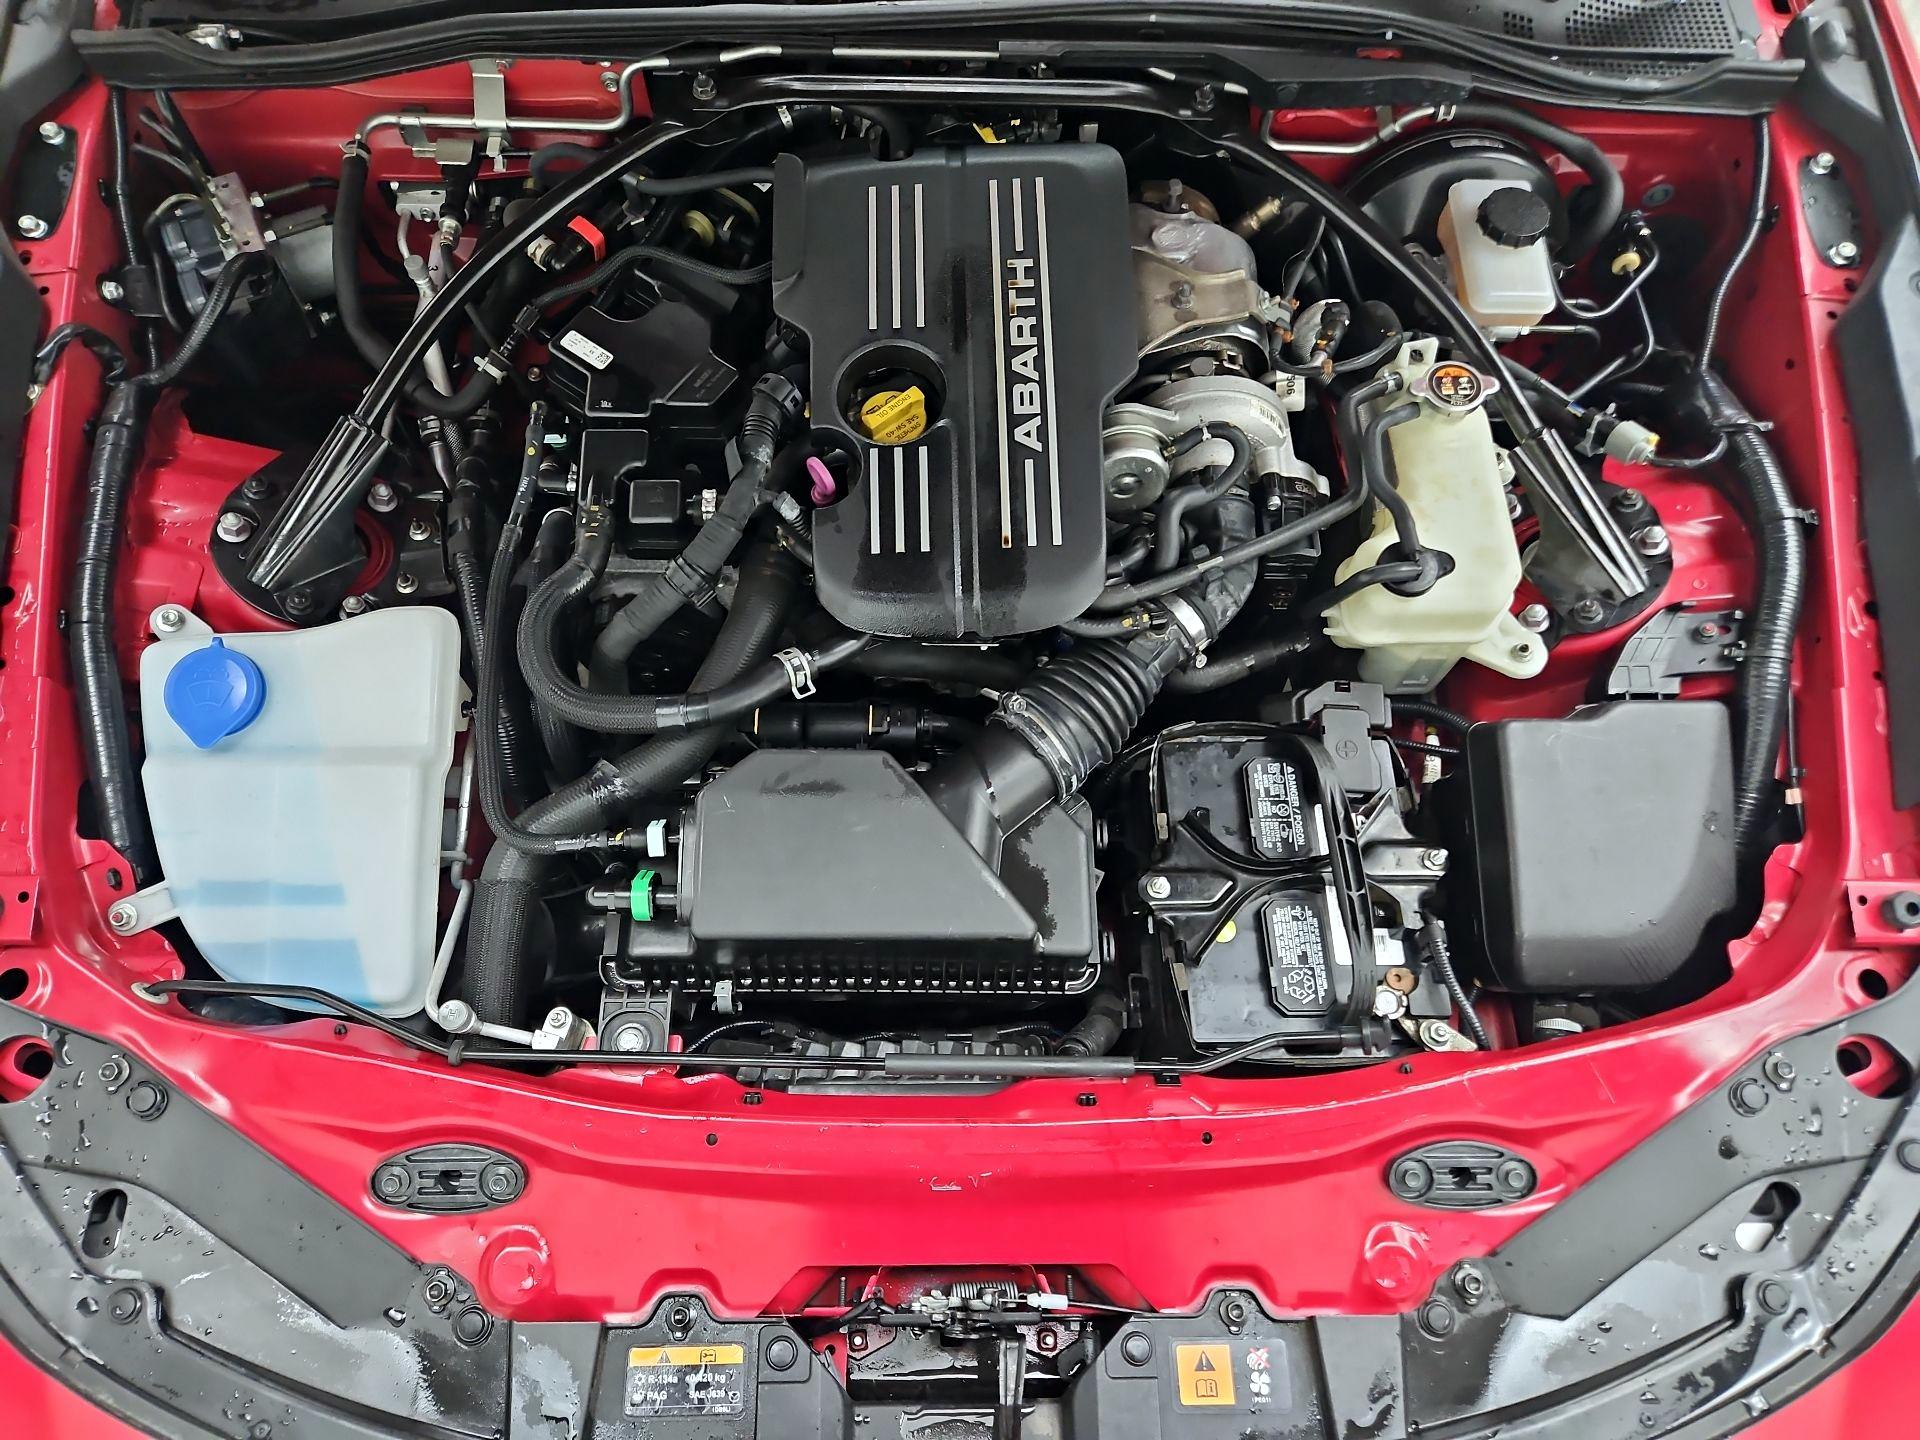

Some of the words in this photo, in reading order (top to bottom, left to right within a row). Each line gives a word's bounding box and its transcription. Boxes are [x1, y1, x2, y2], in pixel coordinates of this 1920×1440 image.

[1007, 258, 1043, 452] ABARTH
[888, 394, 912, 412] ENGINE
[876, 409, 889, 419] OIL
[905, 414, 919, 425] SAE
[886, 423, 907, 438] 5W-40
[894, 421, 922, 441] SYNTHETIC
[1288, 774, 1300, 807] DANGER
[1293, 814, 1306, 846] POISON
[648, 1374, 678, 1384] R-134a
[714, 1373, 726, 1383] kg
[647, 1390, 668, 1400] PAG
[689, 1390, 706, 1399] SAE
